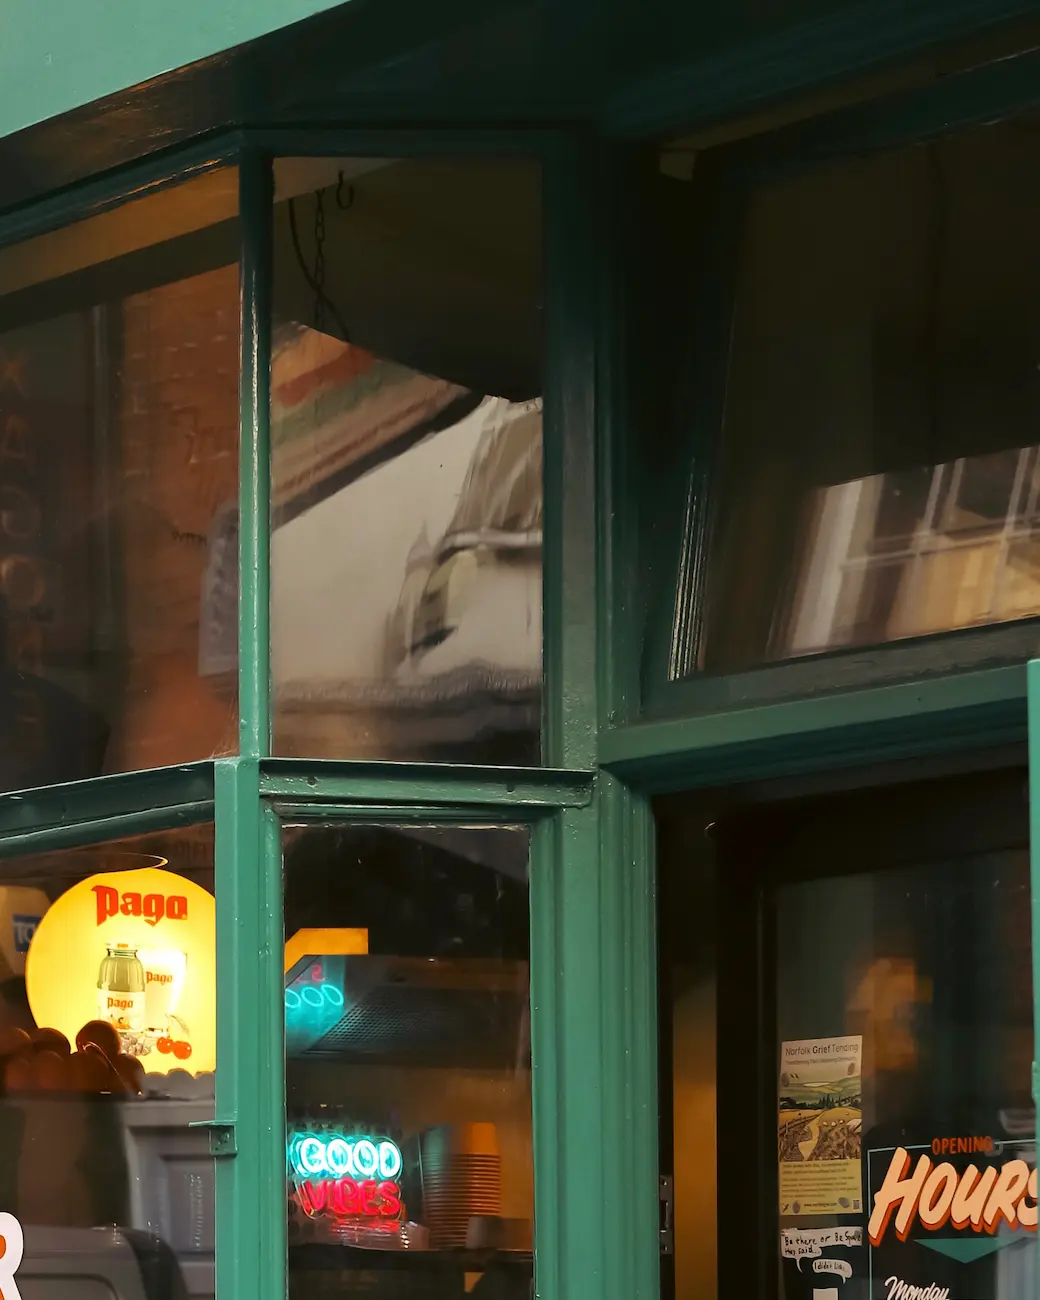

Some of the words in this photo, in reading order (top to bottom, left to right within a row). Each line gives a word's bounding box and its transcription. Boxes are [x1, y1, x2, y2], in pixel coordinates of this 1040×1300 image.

[785, 1045, 811, 1056] Norfolk
[812, 1045, 831, 1055] Grief
[832, 1043, 859, 1055] Tending
[931, 1136, 994, 1156] OPENING
[299, 1136, 401, 1178] GOOD
[302, 1177, 400, 1215] VIBES
[796, 1236, 817, 1246] there
